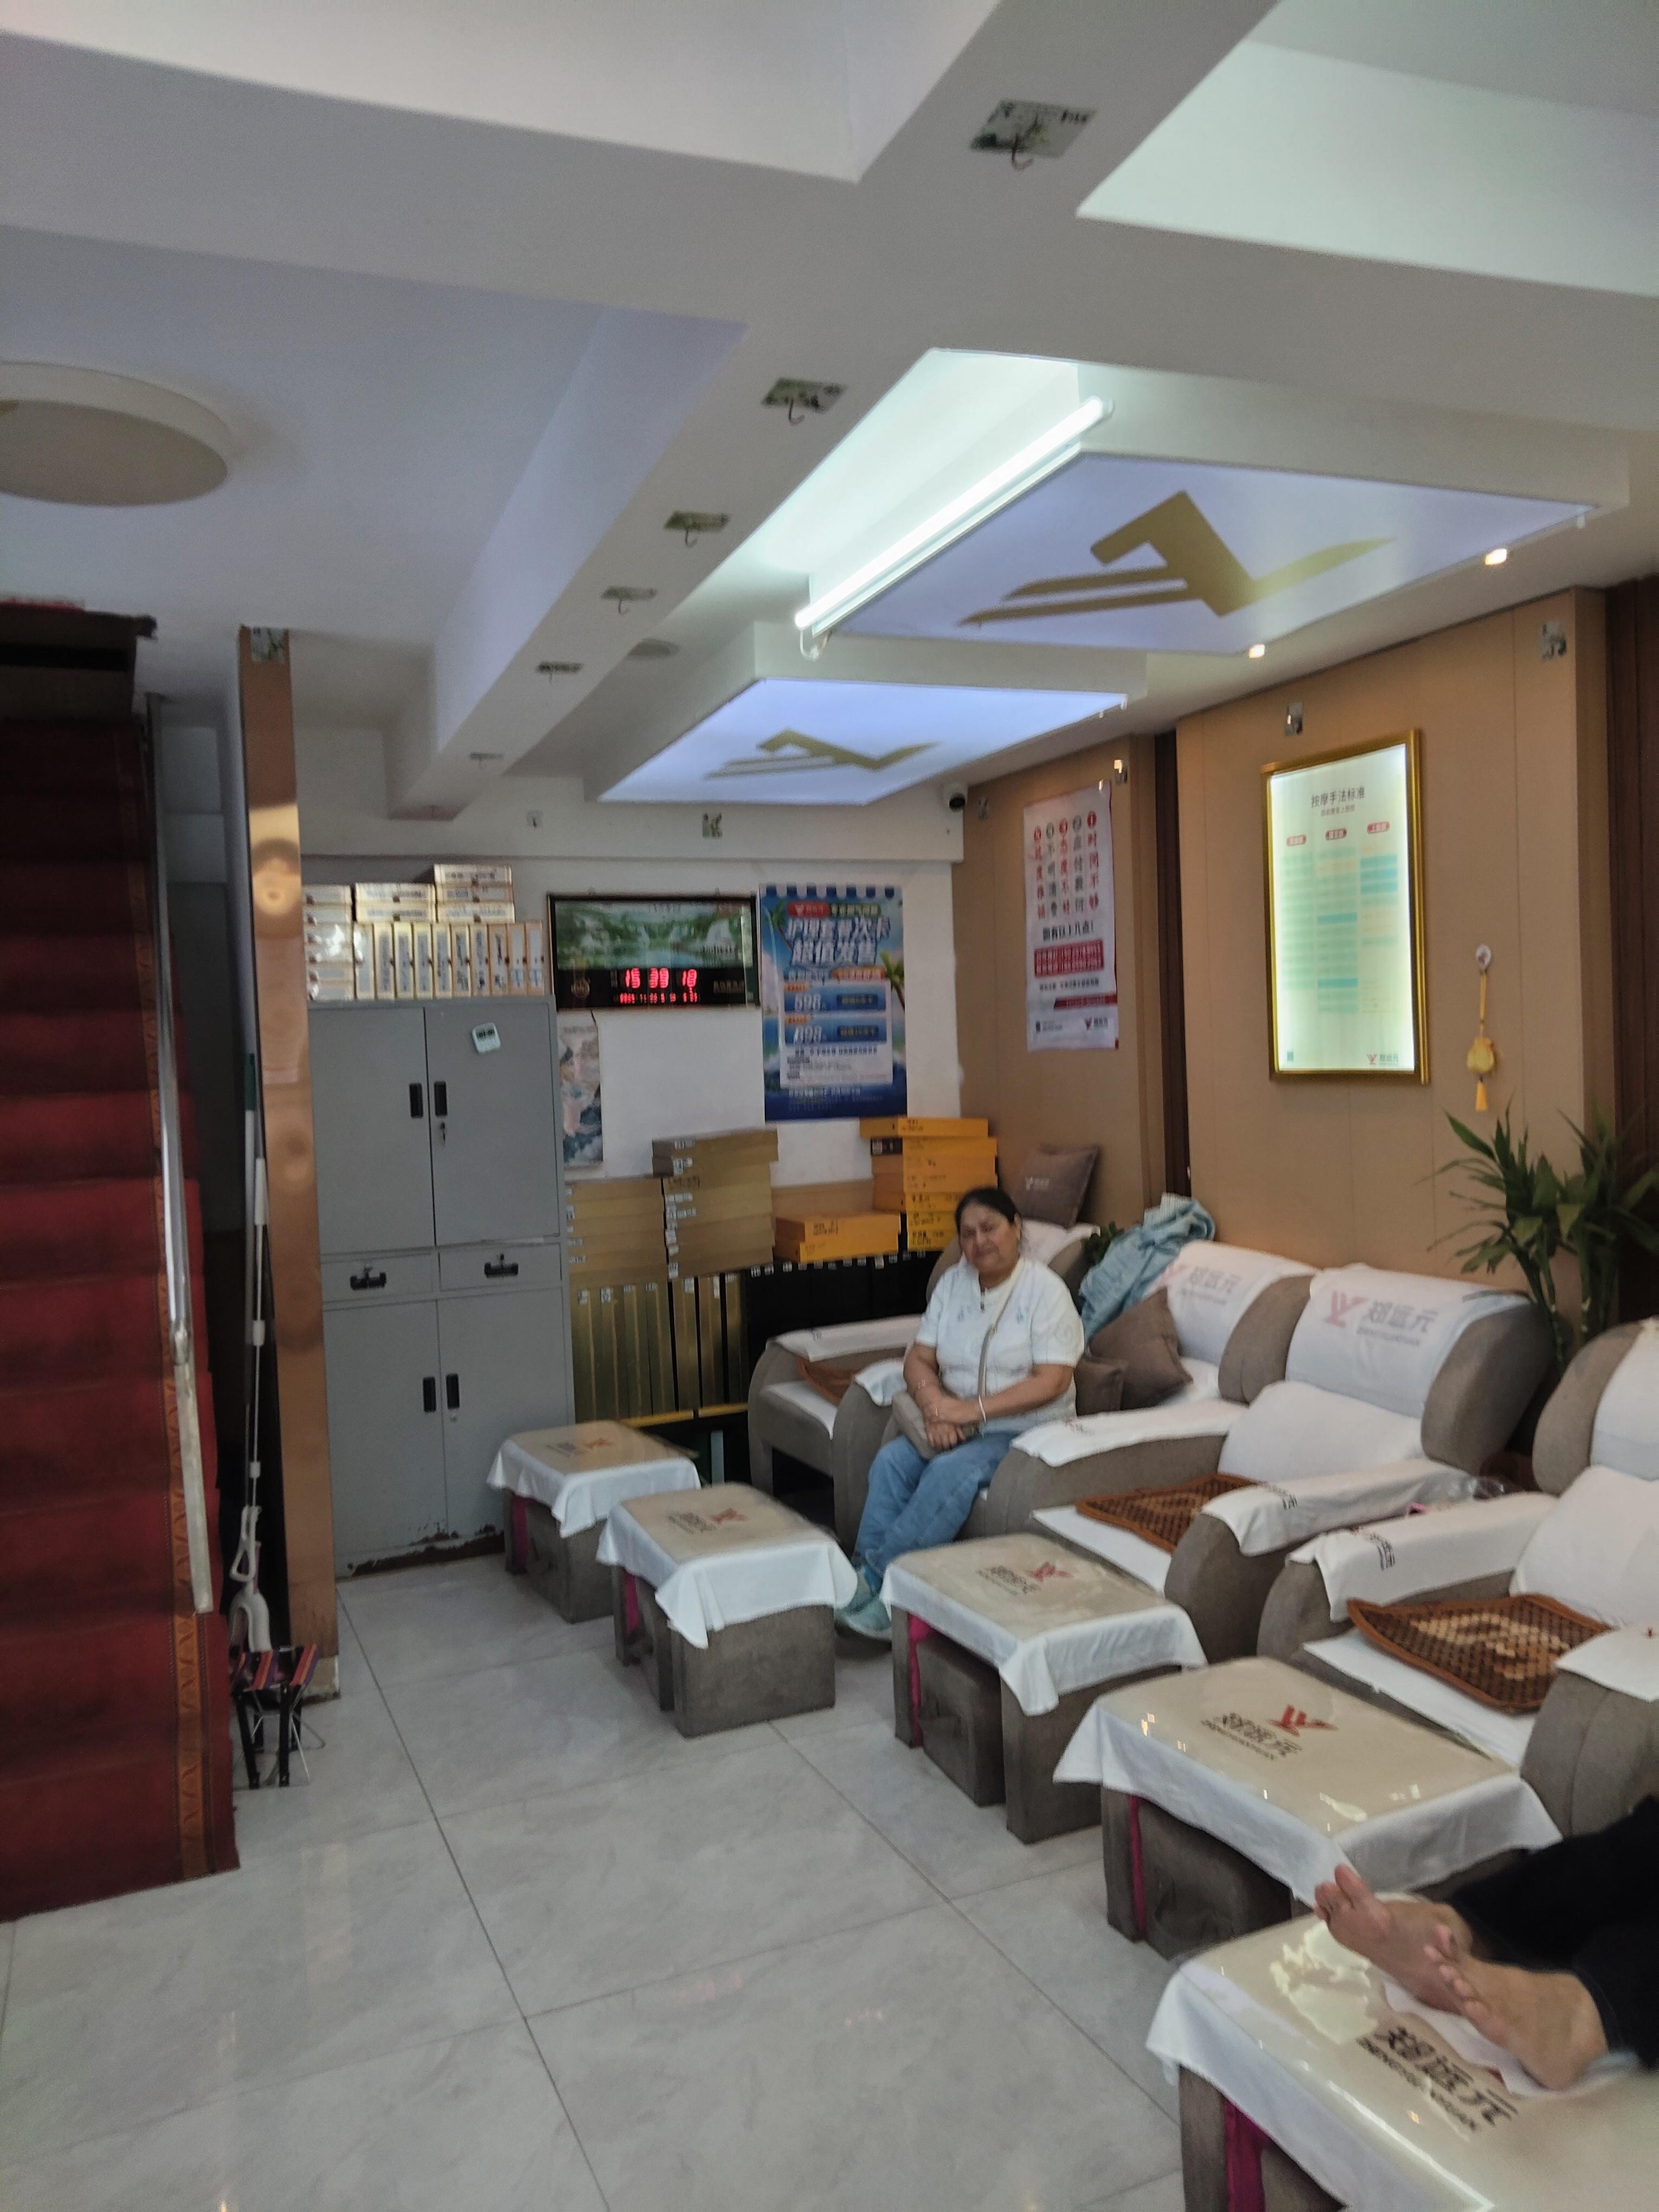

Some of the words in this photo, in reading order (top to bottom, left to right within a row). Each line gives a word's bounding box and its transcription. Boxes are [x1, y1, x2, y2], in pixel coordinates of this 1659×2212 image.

[1311, 786, 1365, 808] 按摩手法标准
